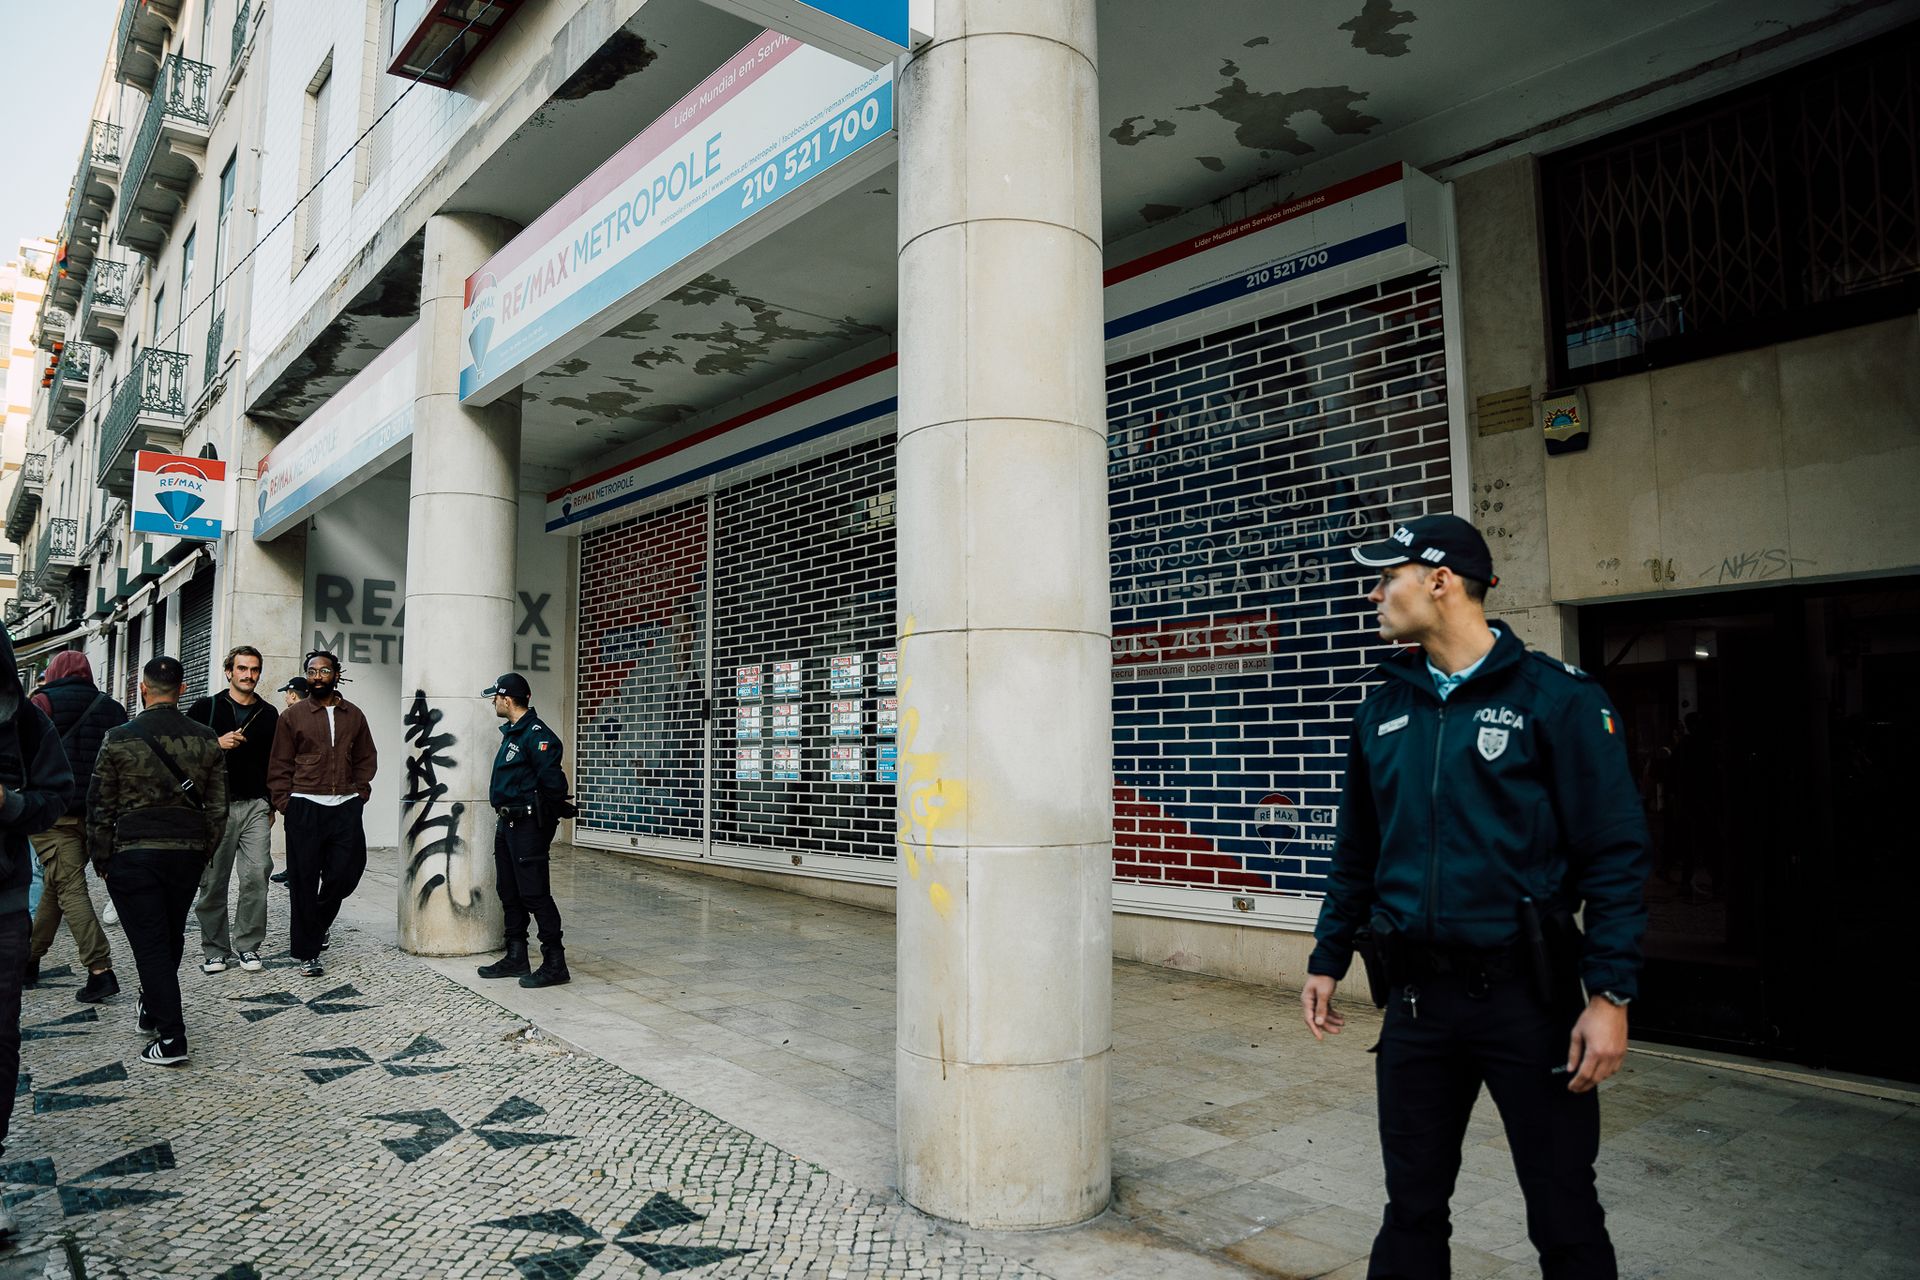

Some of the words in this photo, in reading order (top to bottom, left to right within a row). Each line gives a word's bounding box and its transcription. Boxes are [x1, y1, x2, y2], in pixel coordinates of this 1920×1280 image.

[673, 102, 698, 129] Líder
[699, 72, 736, 106] Mundial
[739, 60, 755, 78] em
[741, 164, 778, 210] 210
[784, 135, 821, 181] 521
[828, 97, 880, 154] 700
[502, 246, 570, 325] RE/MAX
[573, 131, 723, 274] METROPOLE
[1194, 235, 1211, 248] Líder
[1212, 225, 1239, 241] Mundial
[1240, 222, 1251, 232] em
[1252, 211, 1282, 228] Serviços
[1283, 195, 1325, 215] Imobiliários
[1246, 270, 1270, 289] 210
[1273, 262, 1296, 280] 521
[1300, 250, 1329, 271] 700
[160, 477, 203, 492] RE/MAX
[573, 491, 596, 508] RE/MAX
[596, 475, 634, 498] METROPOLE
[1130, 509, 1174, 539] SEU
[1131, 537, 1216, 573] NOSSO
[1225, 513, 1368, 558] OBJETIVO
[1472, 706, 1524, 729] POLÍCIA
[1260, 810, 1293, 822] REMAX
[1311, 808, 1332, 823] Gr
[1311, 833, 1337, 852] ME
